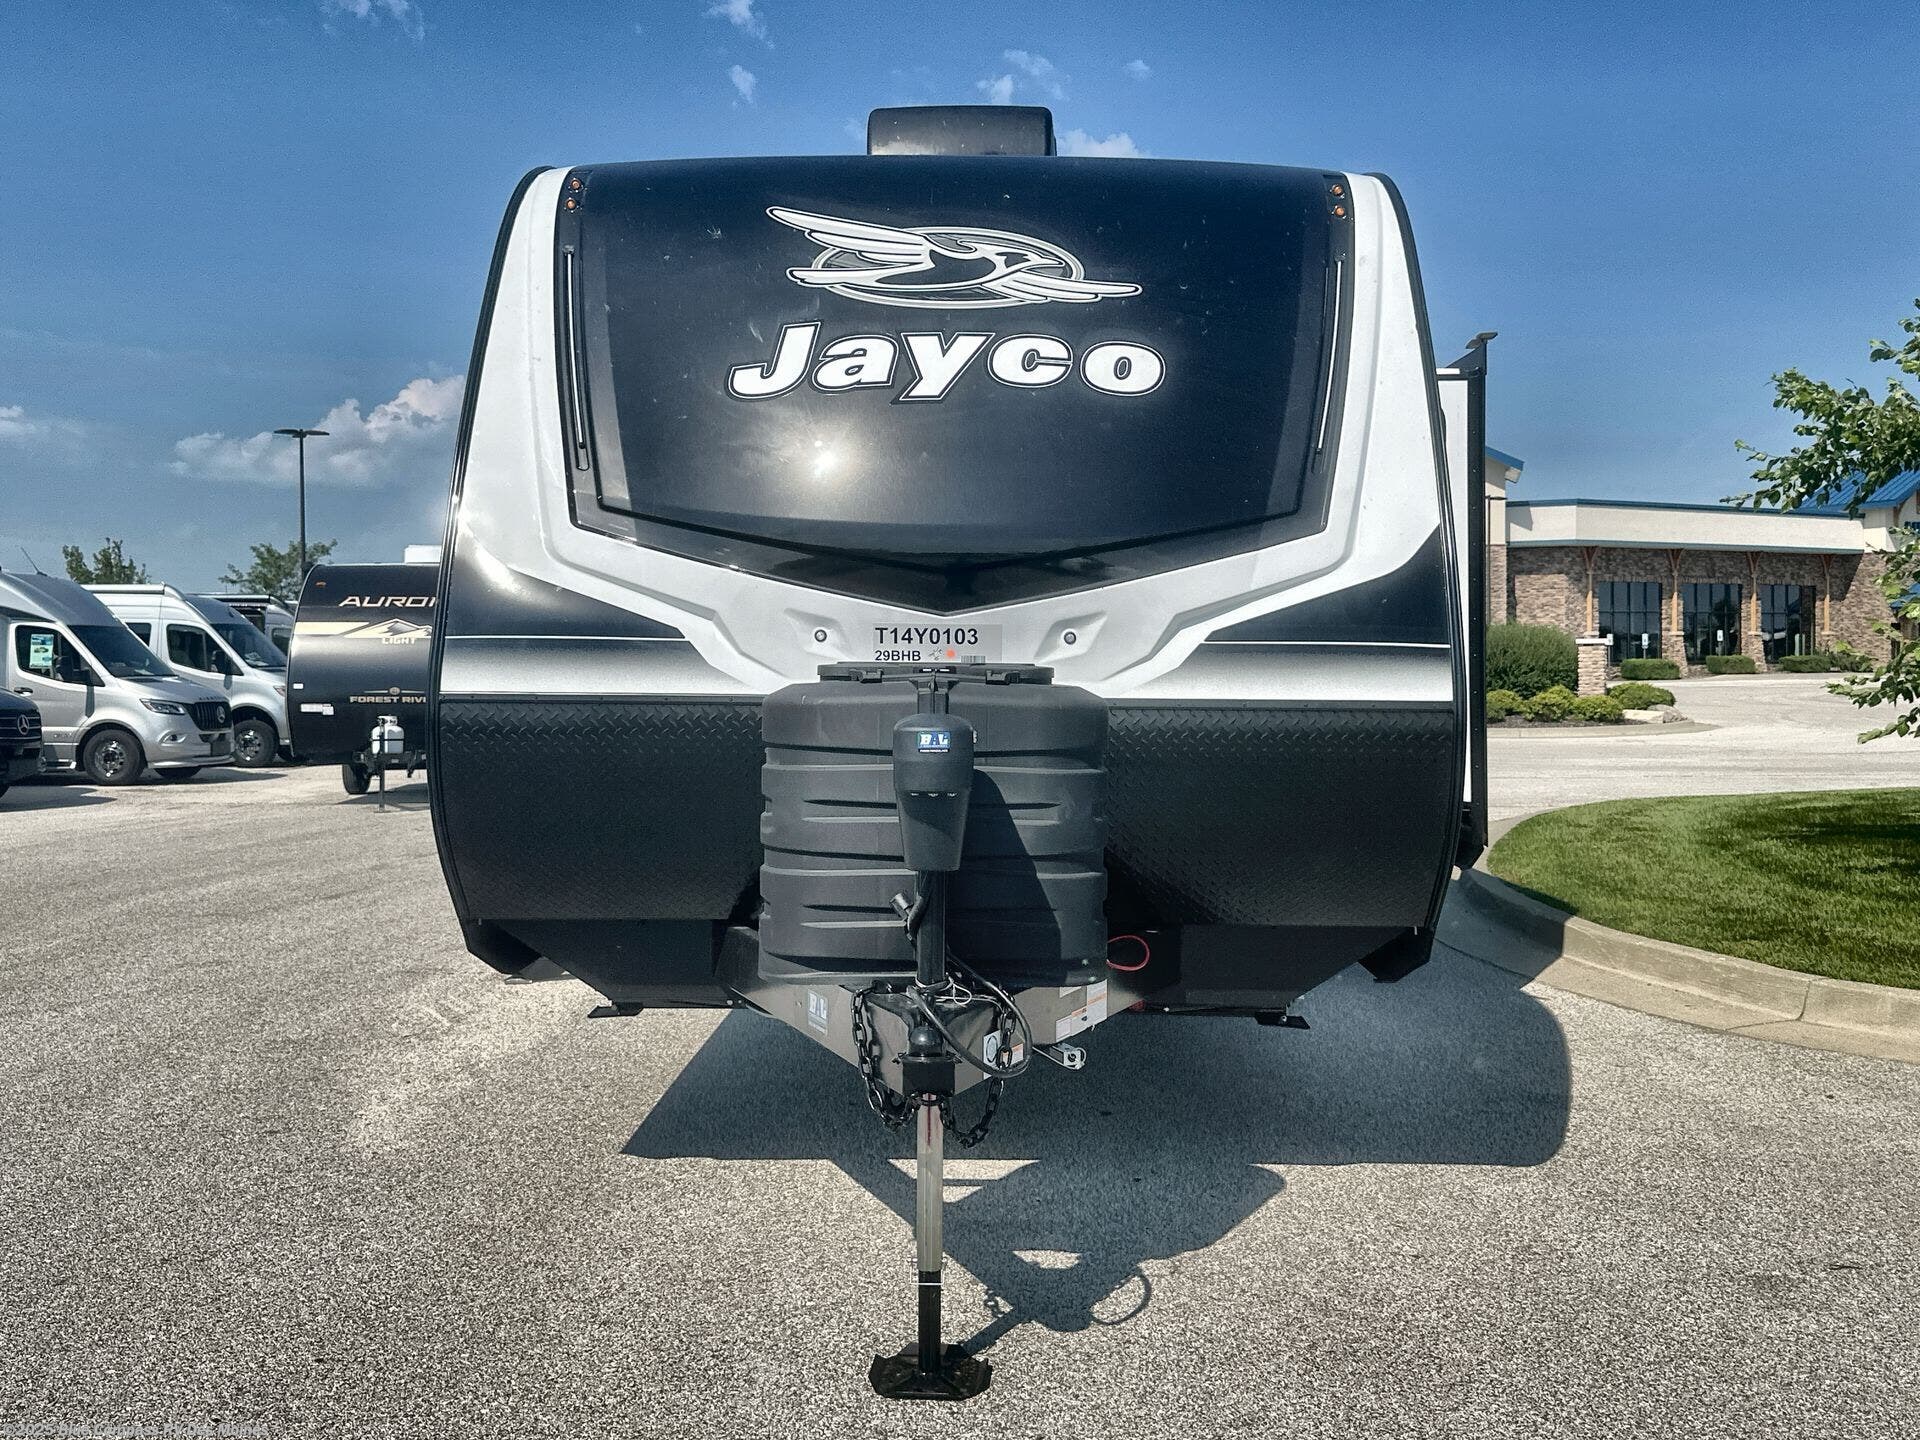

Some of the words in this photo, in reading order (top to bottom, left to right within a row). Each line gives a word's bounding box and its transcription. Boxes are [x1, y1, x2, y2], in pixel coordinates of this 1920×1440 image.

[727, 321, 1167, 403] Jayco
[875, 627, 978, 645] T14Y0103
[875, 650, 921, 661] 29BHB
[349, 696, 400, 704] FOREST
